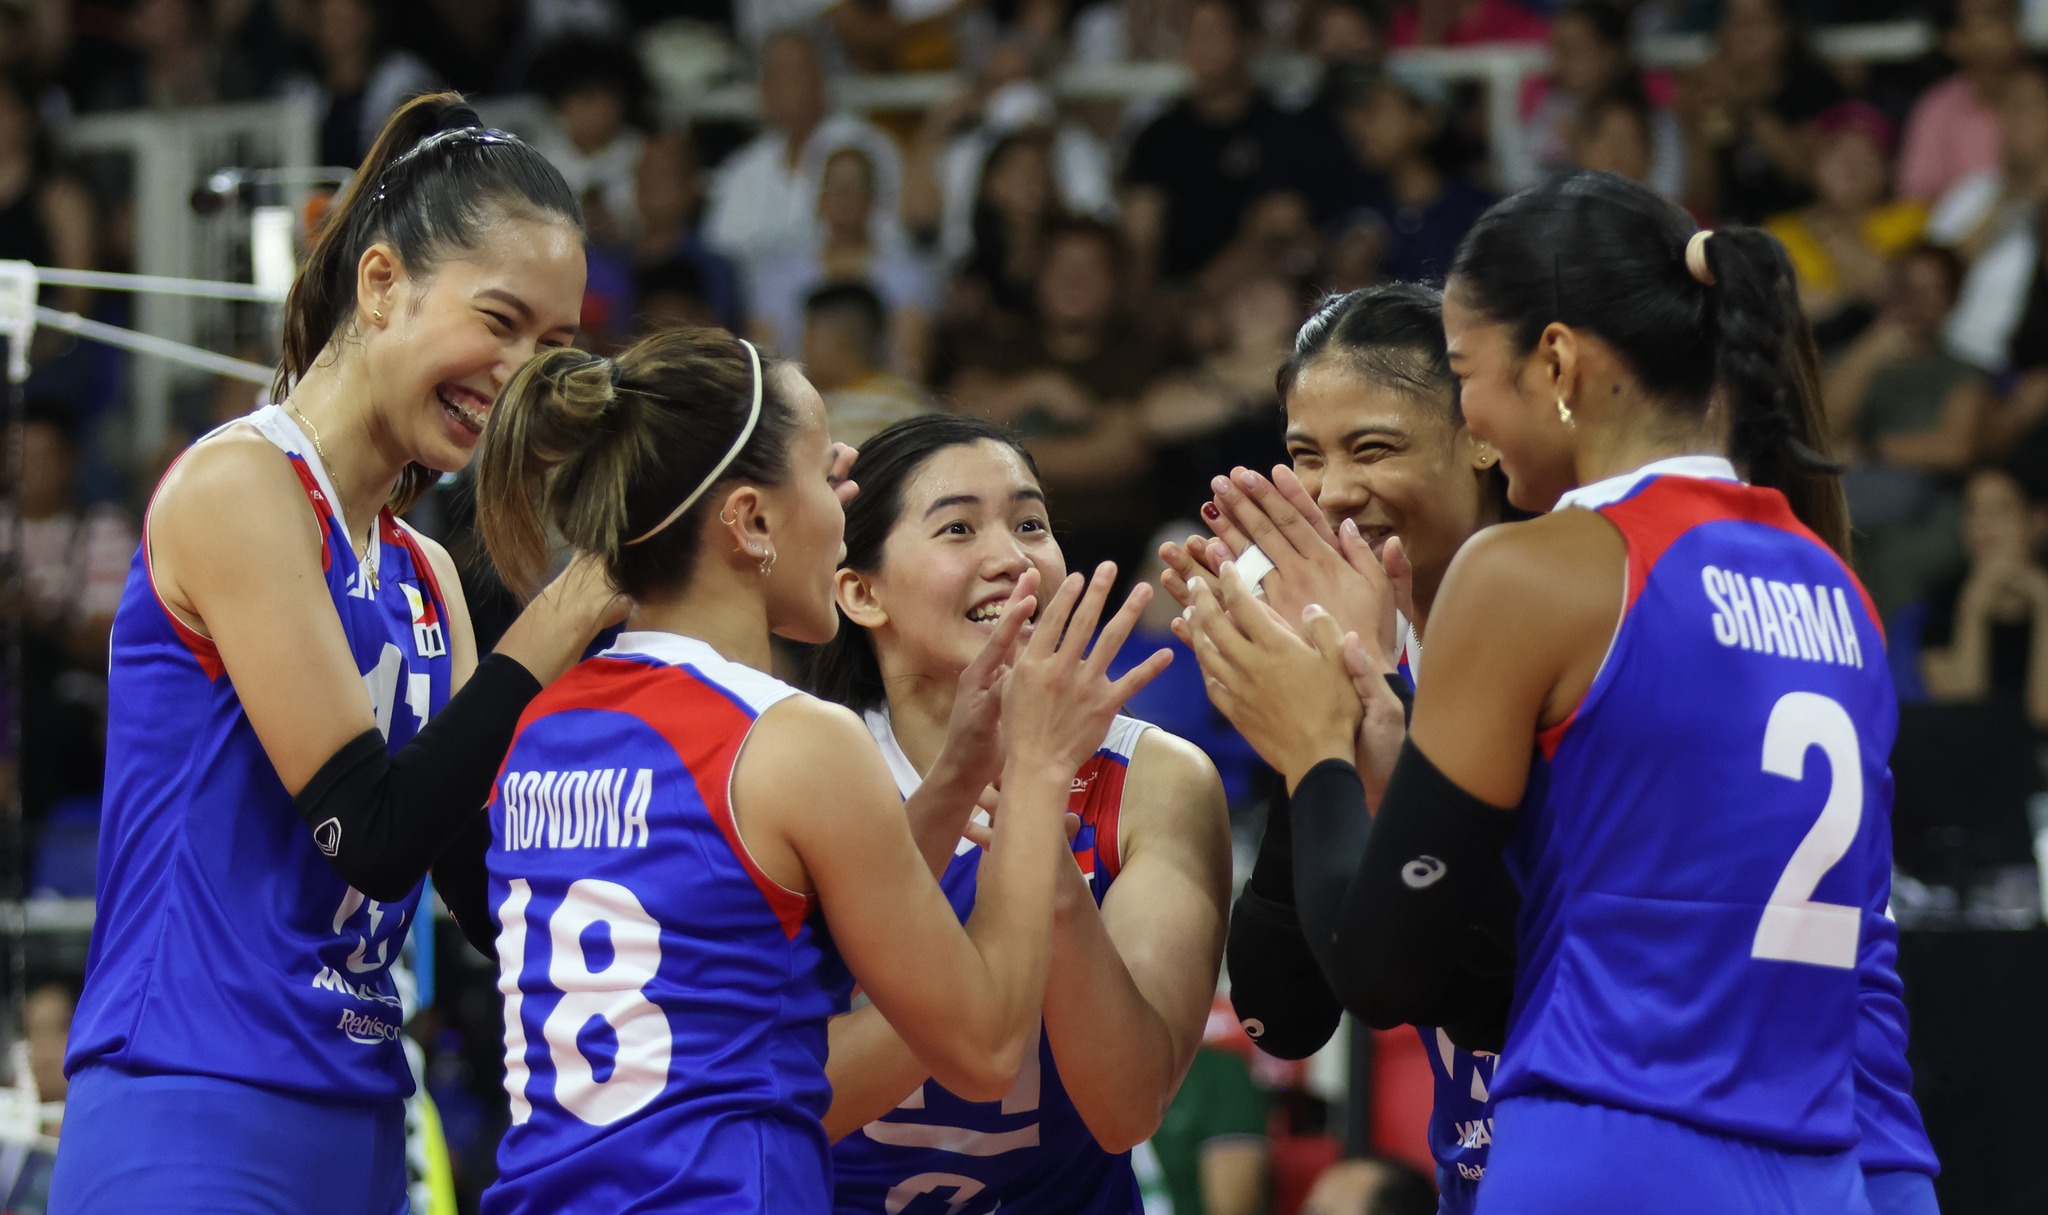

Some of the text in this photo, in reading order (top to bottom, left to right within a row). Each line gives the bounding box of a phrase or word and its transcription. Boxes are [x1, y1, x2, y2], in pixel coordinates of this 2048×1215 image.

[1701, 564, 1864, 670] SHARMA
[503, 767, 654, 852] RONDINA
[1750, 691, 1864, 969] 2
[495, 877, 673, 1126] 18
